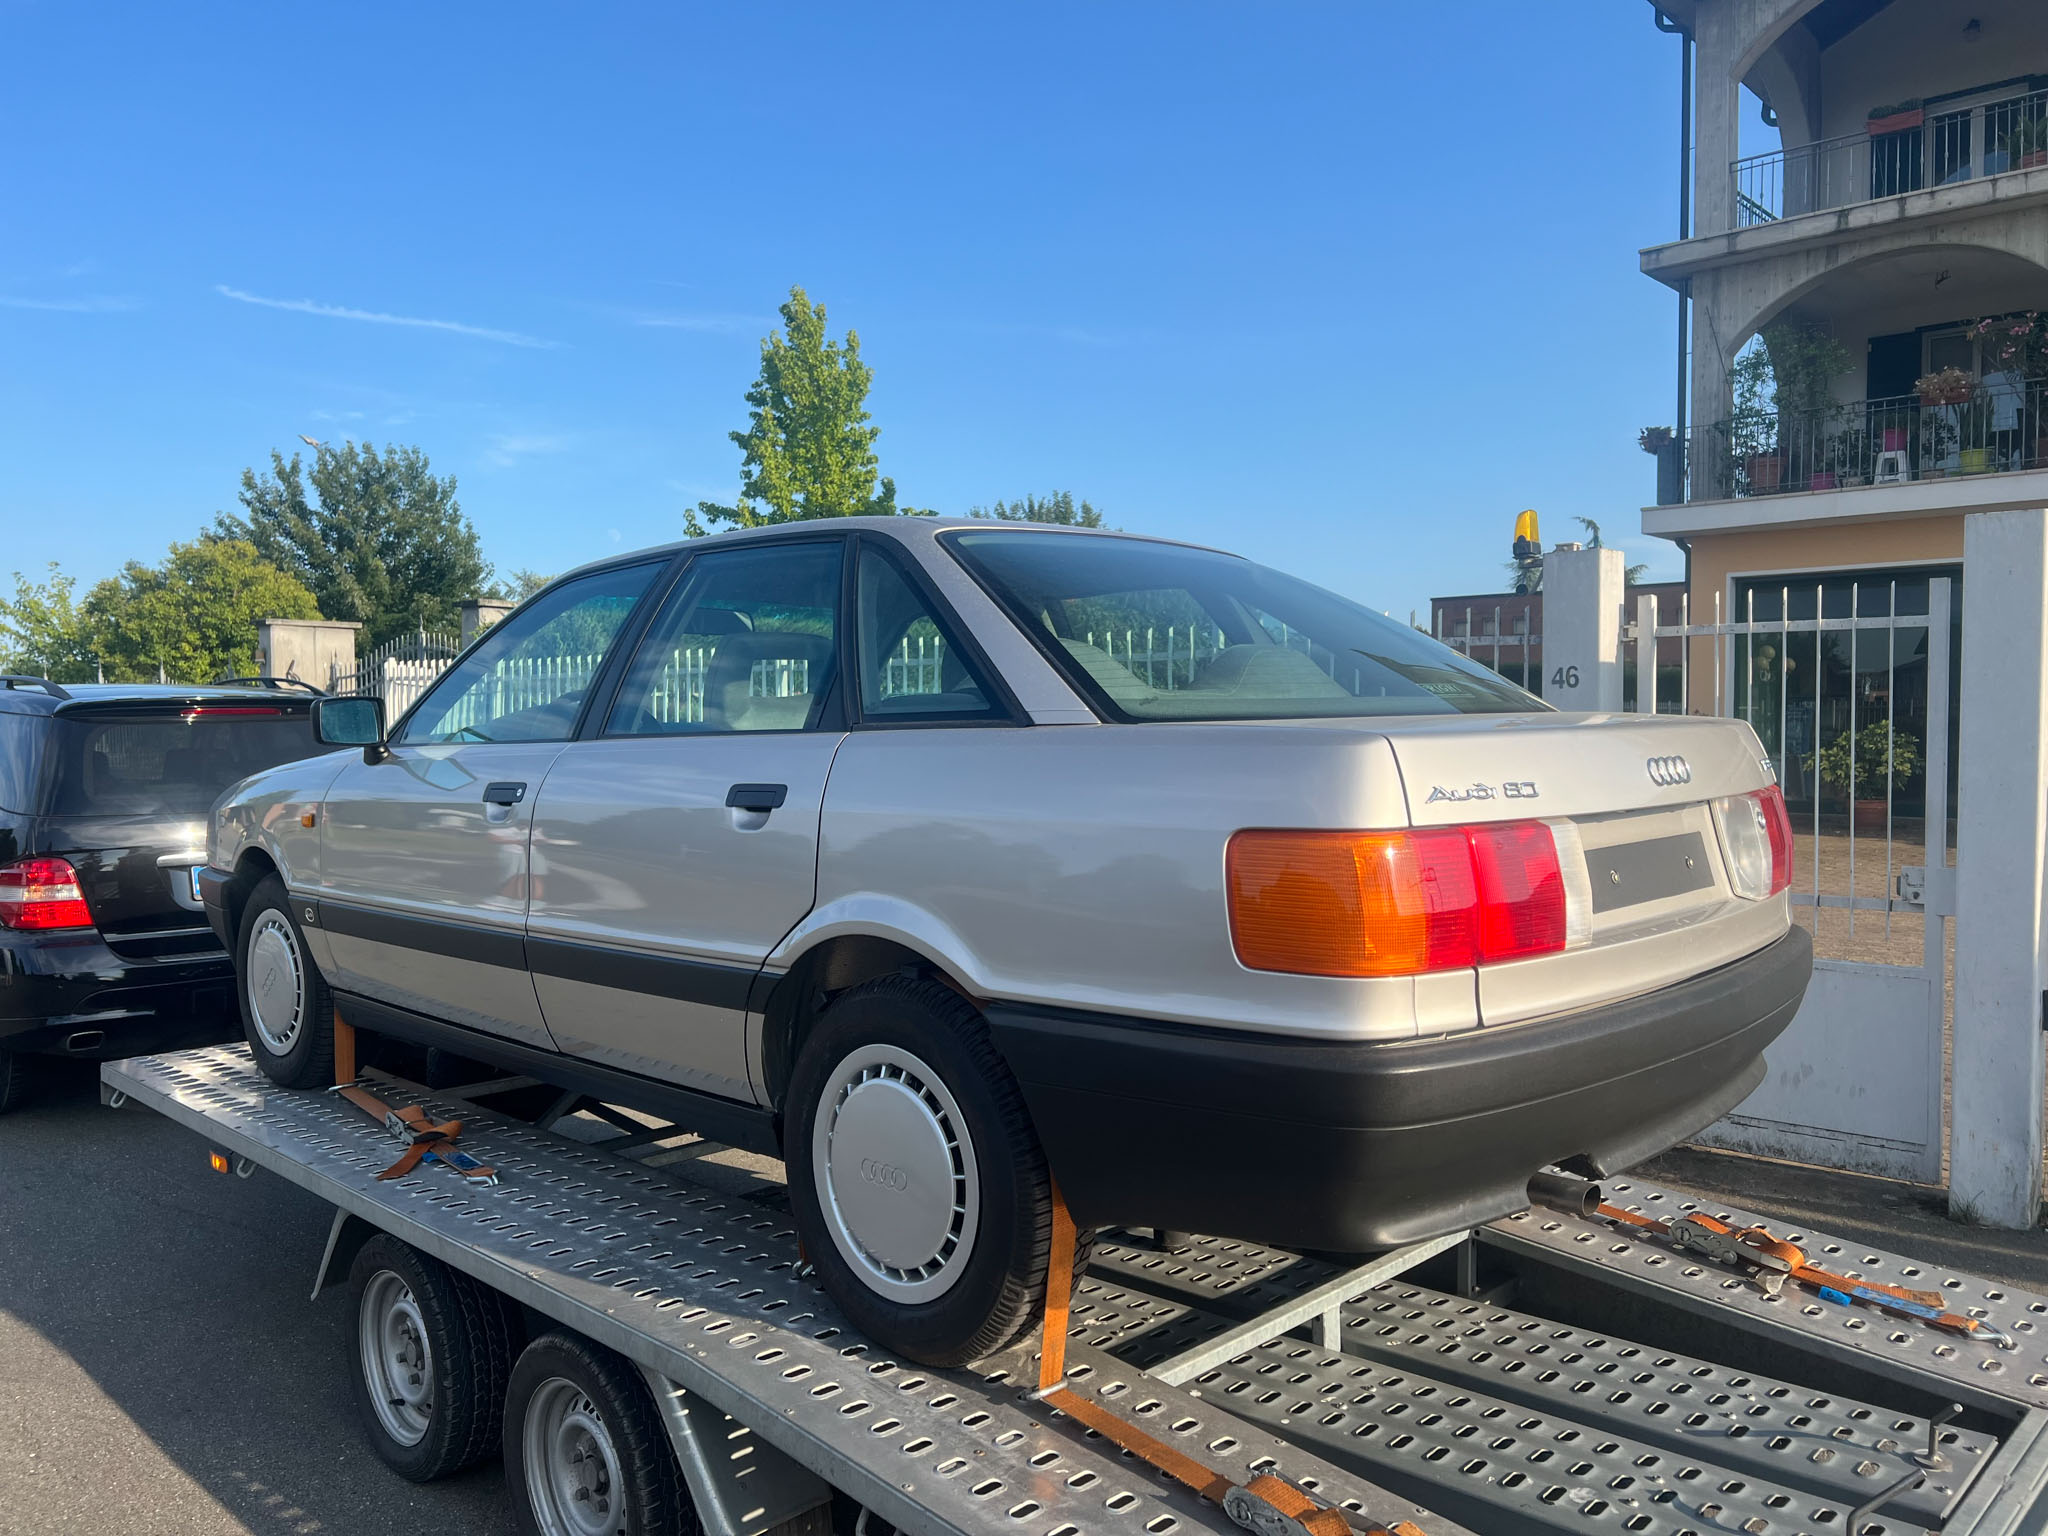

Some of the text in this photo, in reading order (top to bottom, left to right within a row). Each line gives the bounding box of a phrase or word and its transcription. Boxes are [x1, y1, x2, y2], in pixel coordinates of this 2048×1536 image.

[1551, 665, 1579, 689] 46
[1425, 781, 1540, 805] Audi 80
